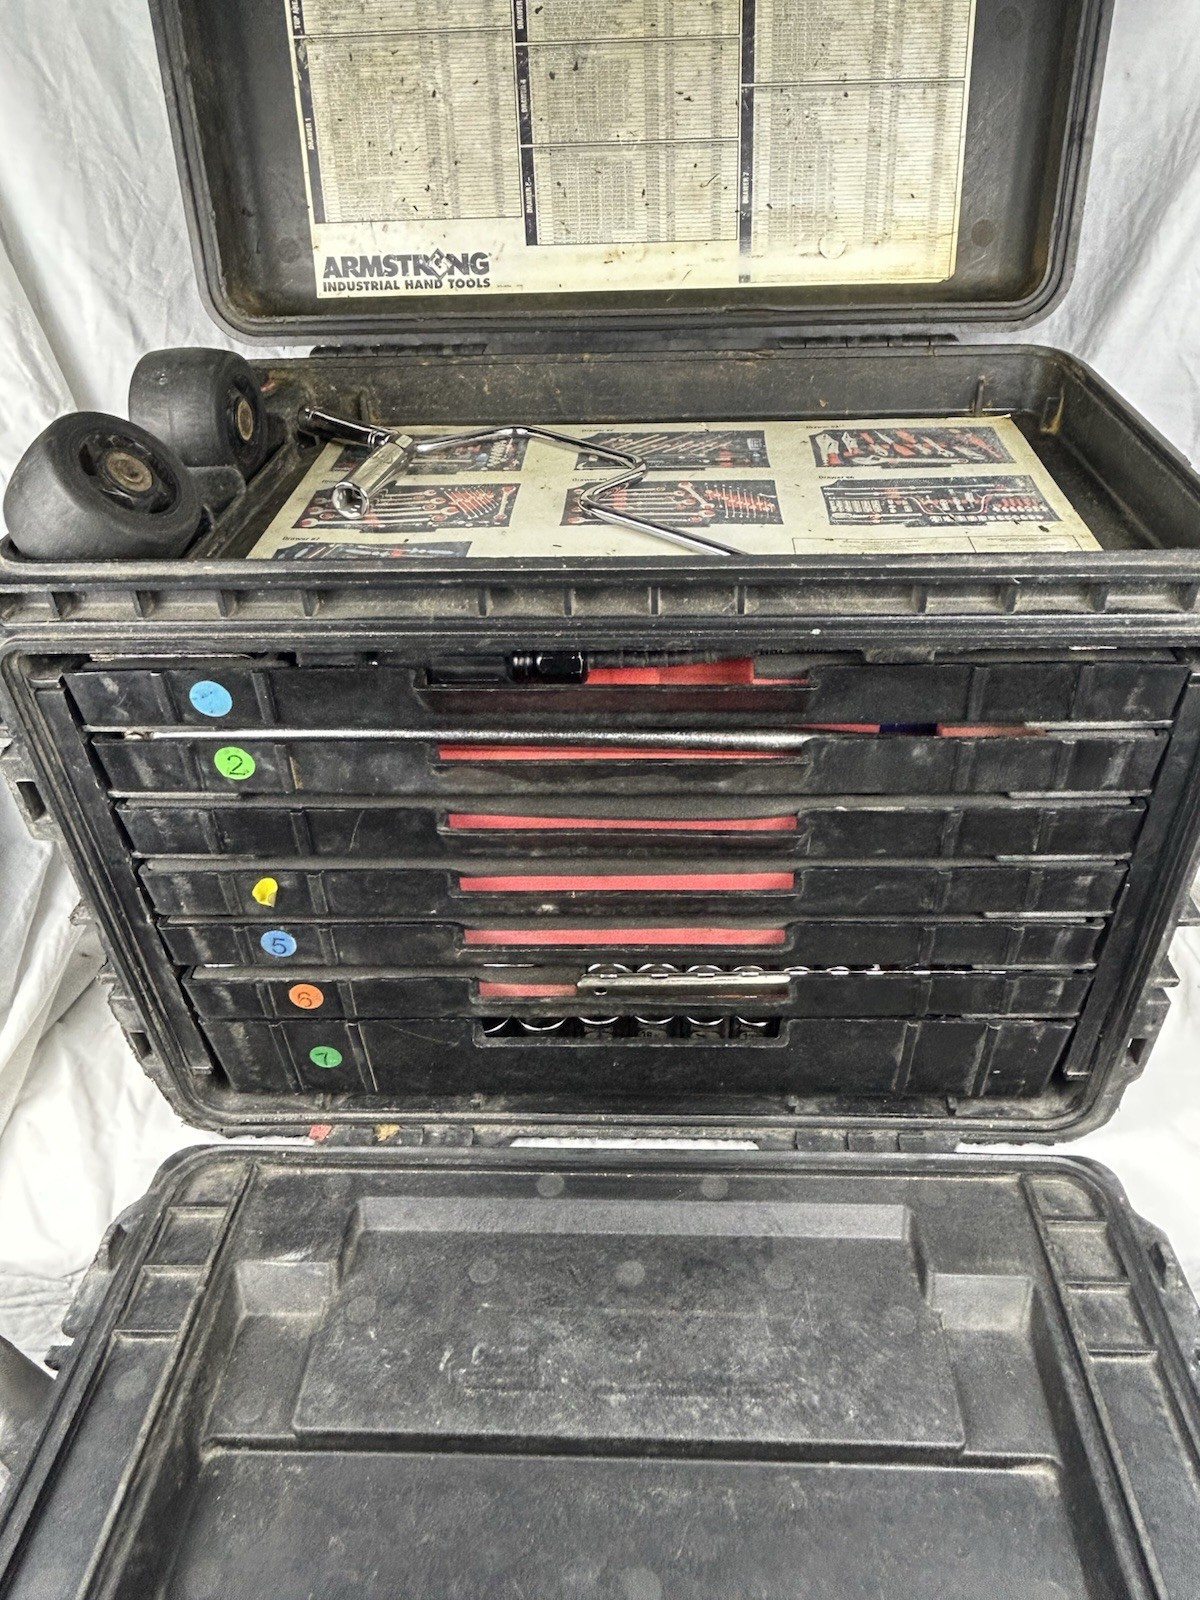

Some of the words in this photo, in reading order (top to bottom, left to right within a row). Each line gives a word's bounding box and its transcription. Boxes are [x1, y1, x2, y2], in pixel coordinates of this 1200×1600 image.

[516, 0, 525, 30] DRAWER
[520, 84, 528, 113] DRAWER
[305, 122, 315, 150] DRAWER
[525, 187, 534, 214] DRAWER
[742, 177, 750, 204] DRAWER
[323, 280, 400, 292] INDUSTRIAL
[405, 279, 443, 290] HAND
[448, 278, 491, 289] TOOLS
[227, 754, 246, 775] 2
[271, 937, 287, 954] 5
[315, 1052, 329, 1066] 7
